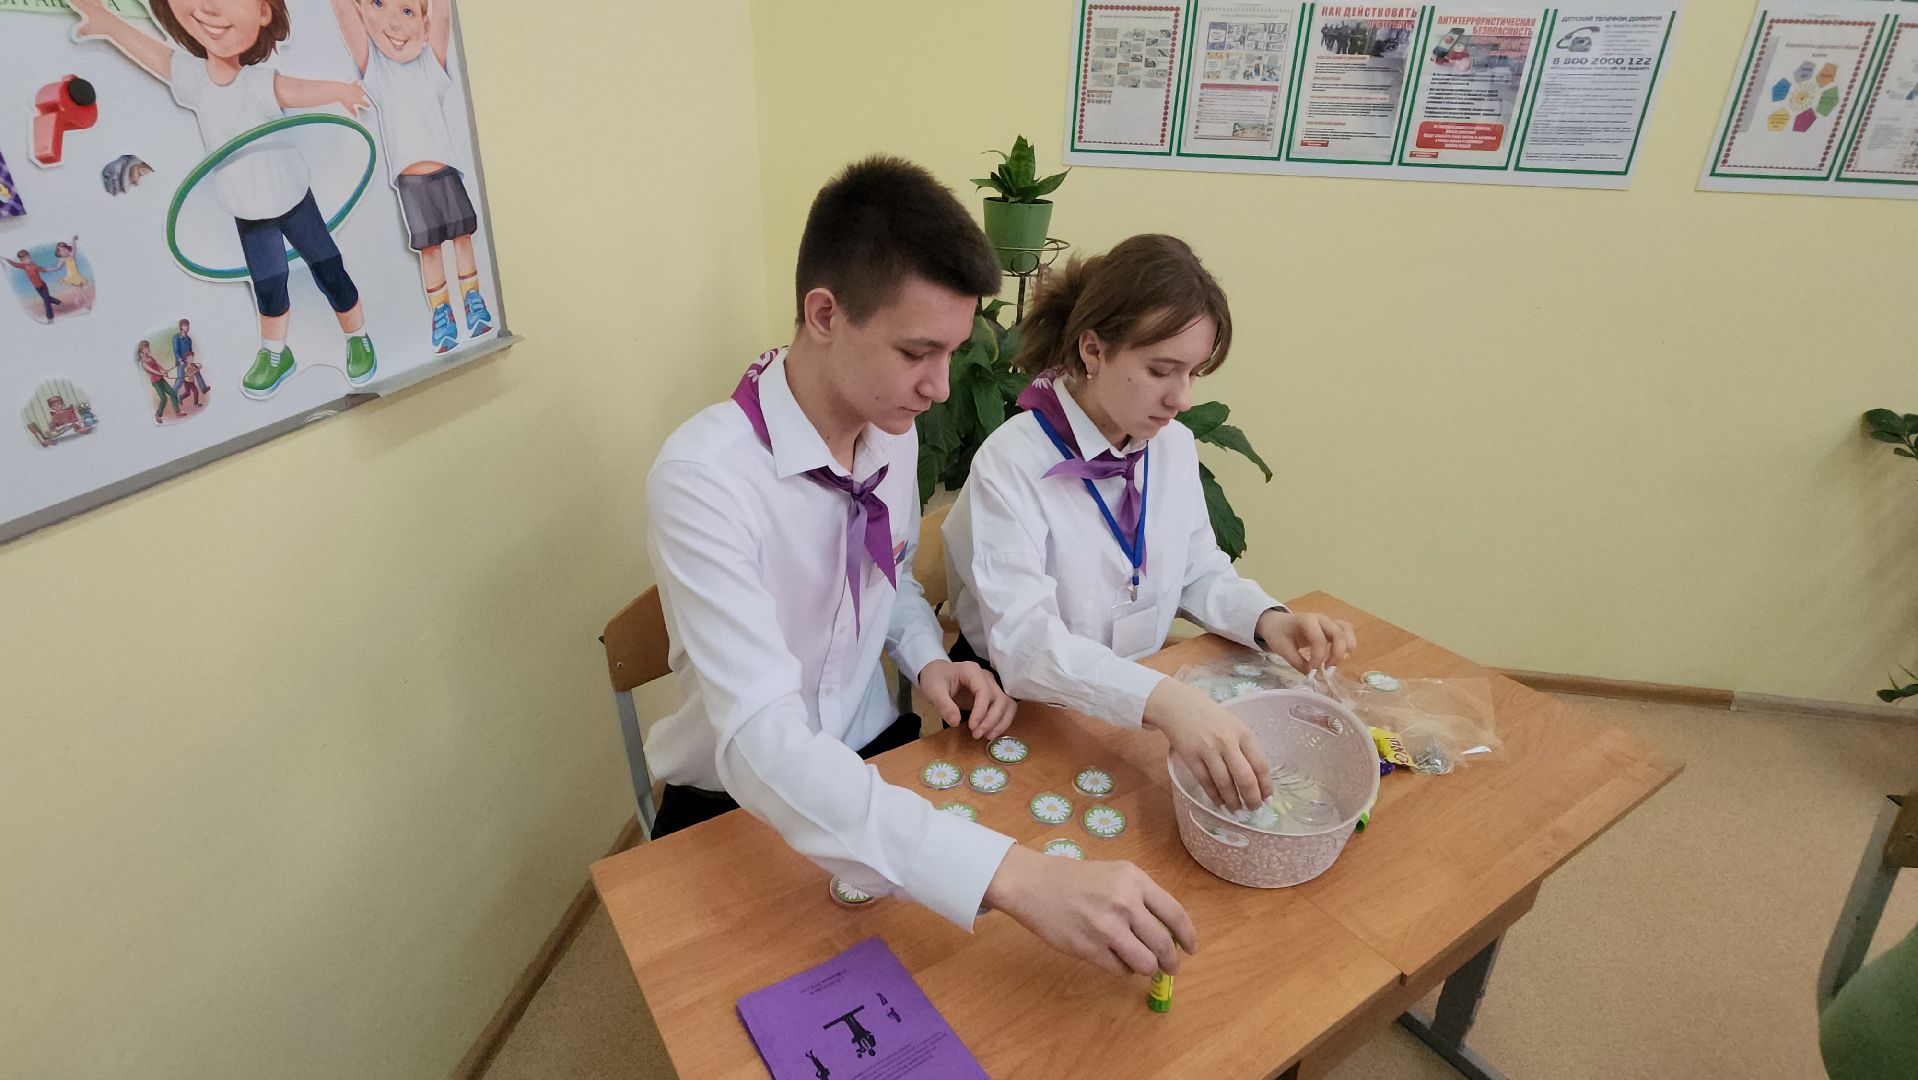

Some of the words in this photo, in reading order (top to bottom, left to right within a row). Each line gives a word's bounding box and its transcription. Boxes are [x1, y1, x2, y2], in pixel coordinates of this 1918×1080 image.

[1343, 5, 1418, 18] ДЕЙСТВОВАТЬ
[1437, 15, 1536, 27] АНТИТЕРРОРИСТИЧЕСКАЯ
[1472, 26, 1533, 36] БЕЗОПАСНОСТЬ
[1552, 57, 1560, 65] 8
[1563, 57, 1588, 65] 800
[1590, 57, 1624, 65] 2000
[1627, 57, 1653, 66] 122
